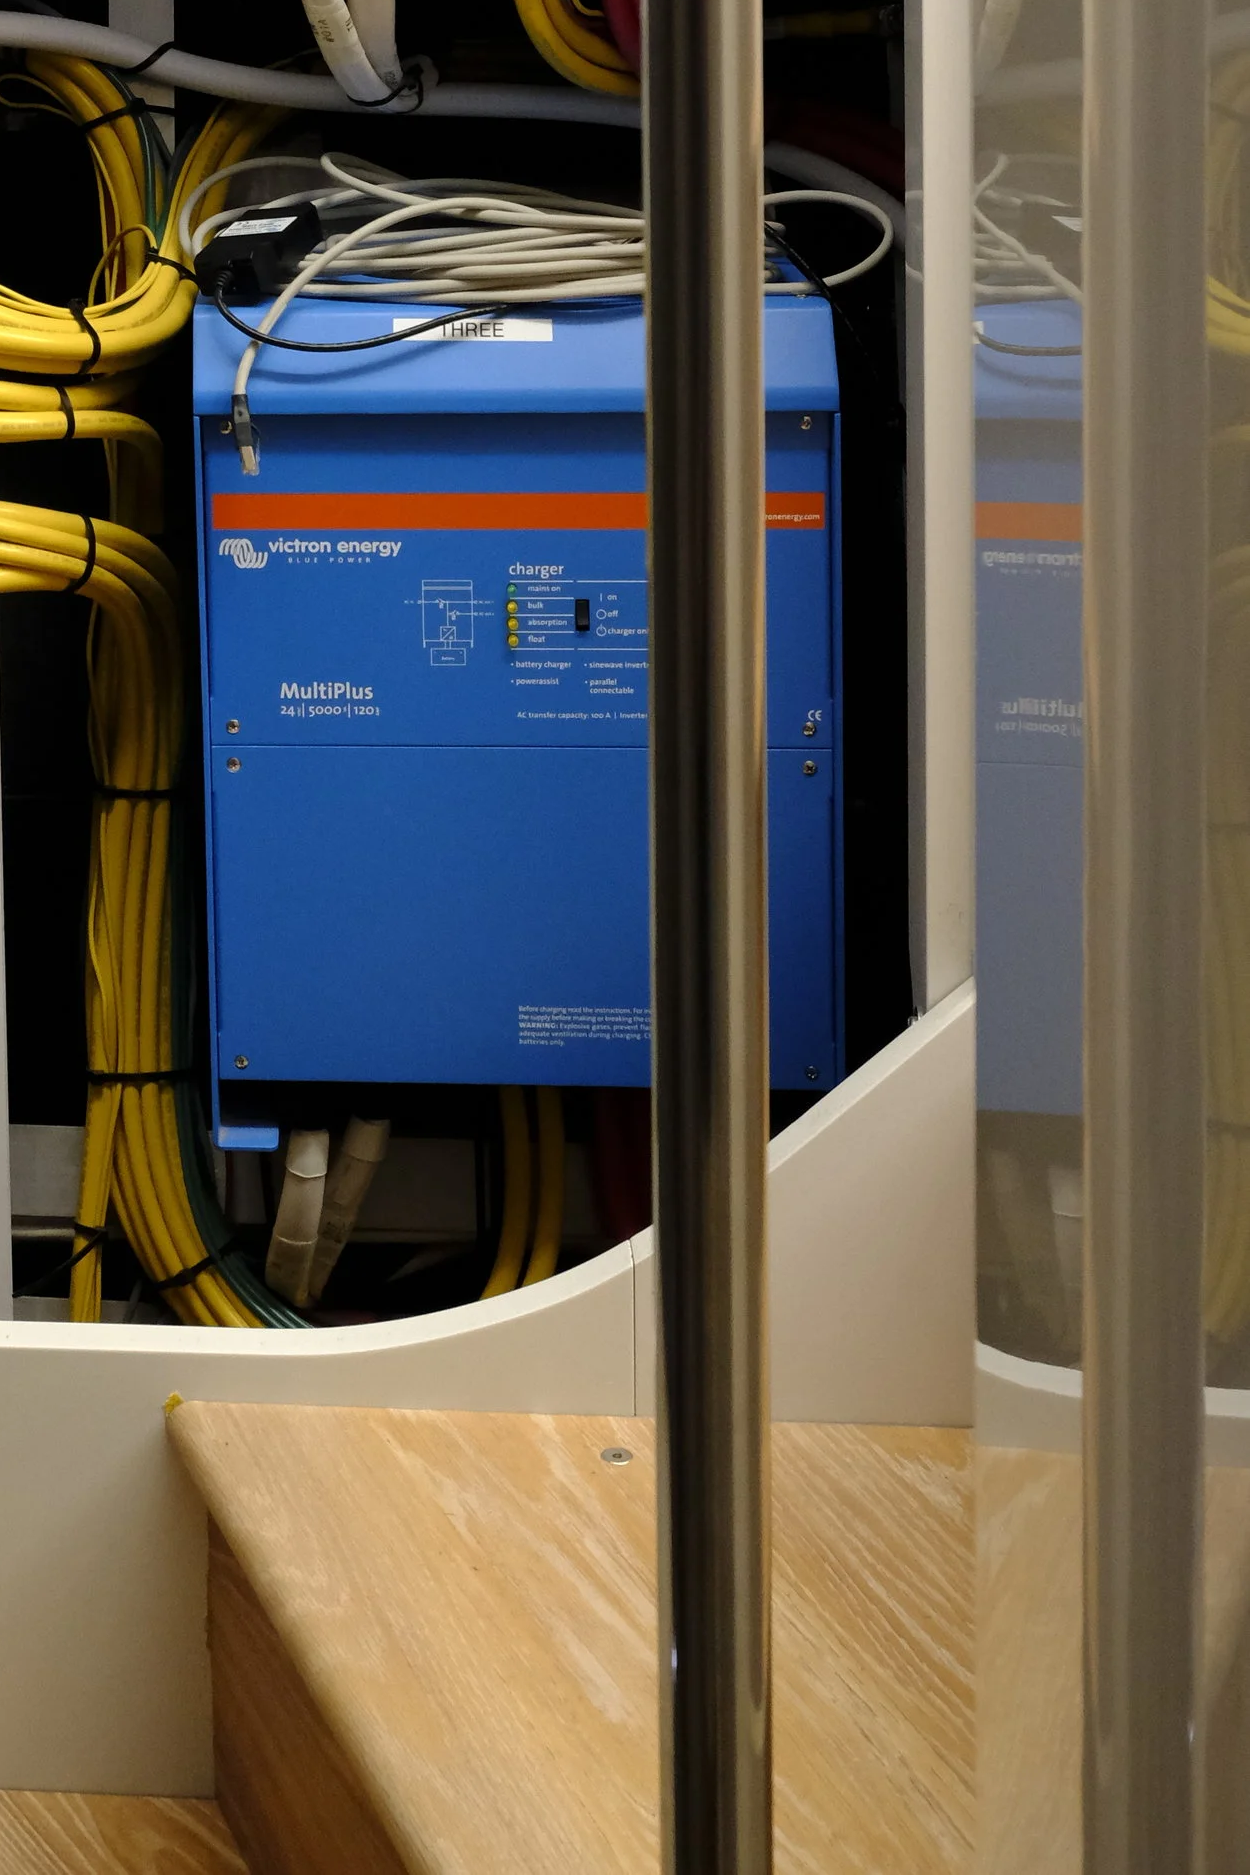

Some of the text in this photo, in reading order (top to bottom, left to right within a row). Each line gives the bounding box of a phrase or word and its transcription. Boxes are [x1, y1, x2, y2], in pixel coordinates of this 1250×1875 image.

[441, 322, 505, 338] THREE
[765, 513, 820, 522] ronenergy.com
[268, 537, 402, 557] victron energy
[508, 562, 564, 579] charger
[528, 601, 543, 609] bulk
[528, 619, 568, 627] absorption
[608, 627, 649, 636] charger on
[528, 635, 546, 643] float
[516, 661, 572, 670] battery charger
[589, 661, 649, 669] sinewave invert
[516, 677, 560, 686] powerassist
[280, 681, 373, 699] MultiPlus
